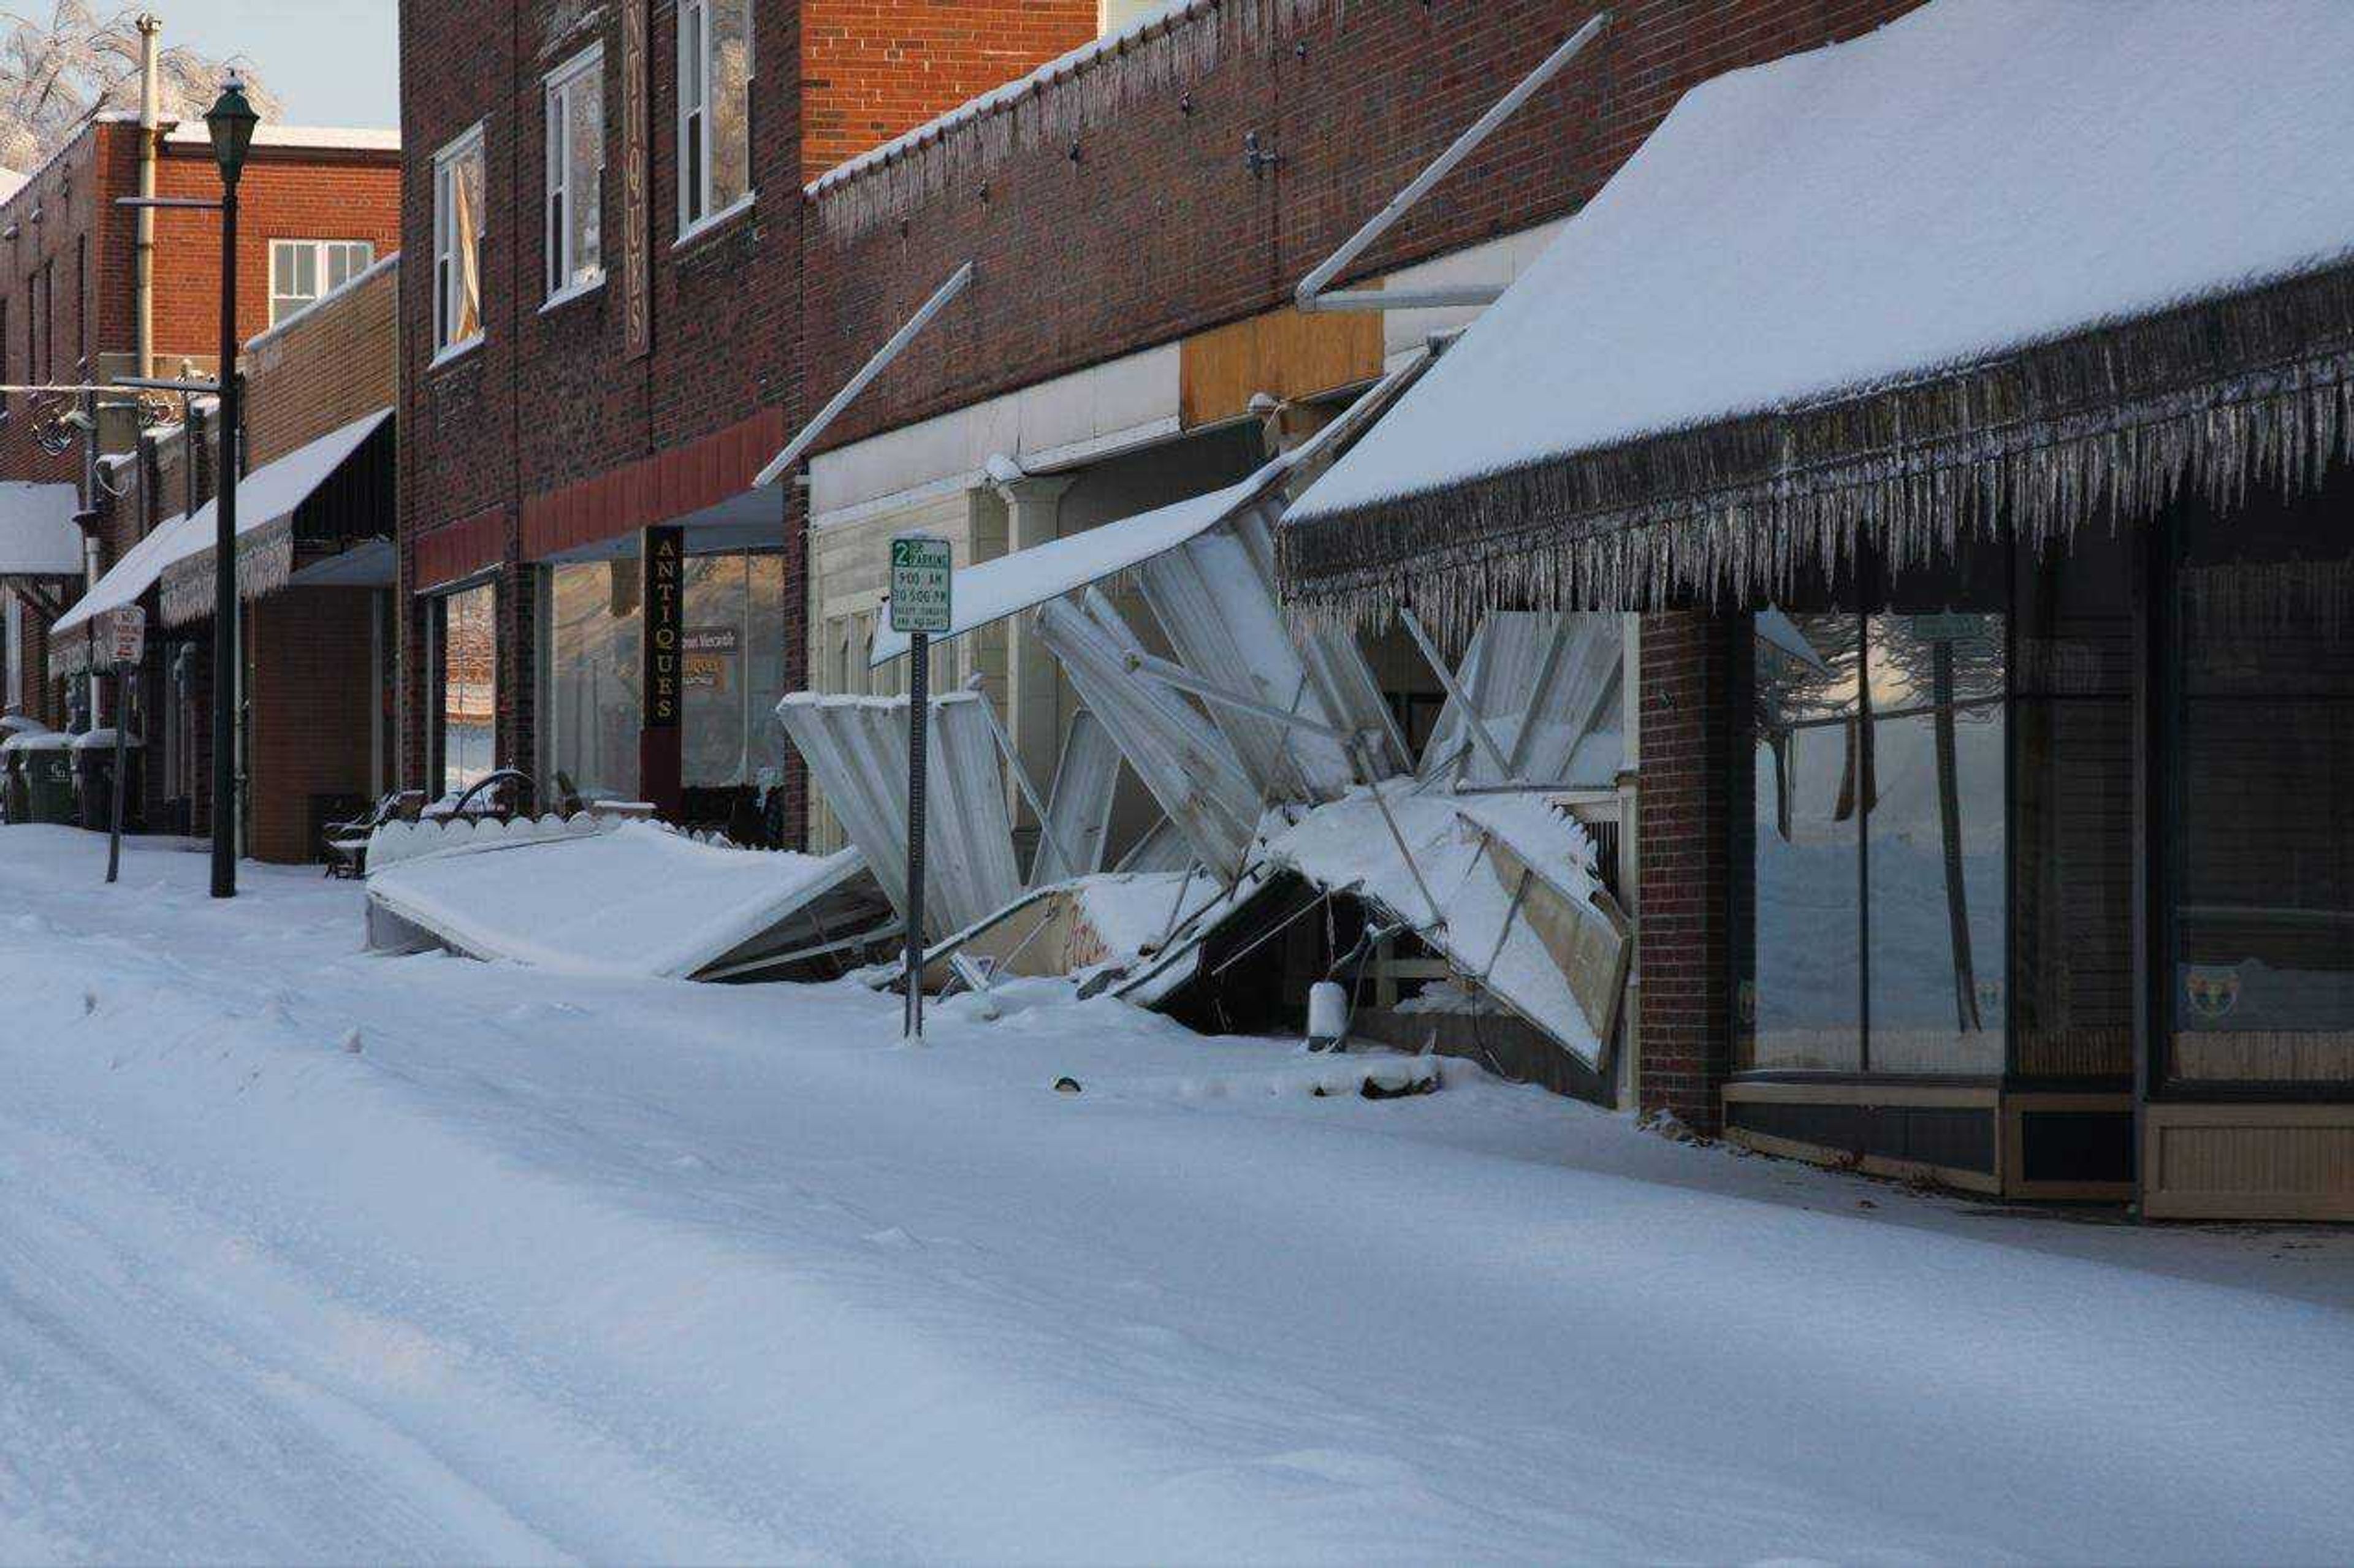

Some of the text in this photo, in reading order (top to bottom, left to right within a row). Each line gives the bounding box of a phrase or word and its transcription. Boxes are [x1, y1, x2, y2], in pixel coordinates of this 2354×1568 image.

[895, 542, 908, 565] 2
[929, 573, 942, 585] AM
[656, 540, 674, 717] ANTIQUES
